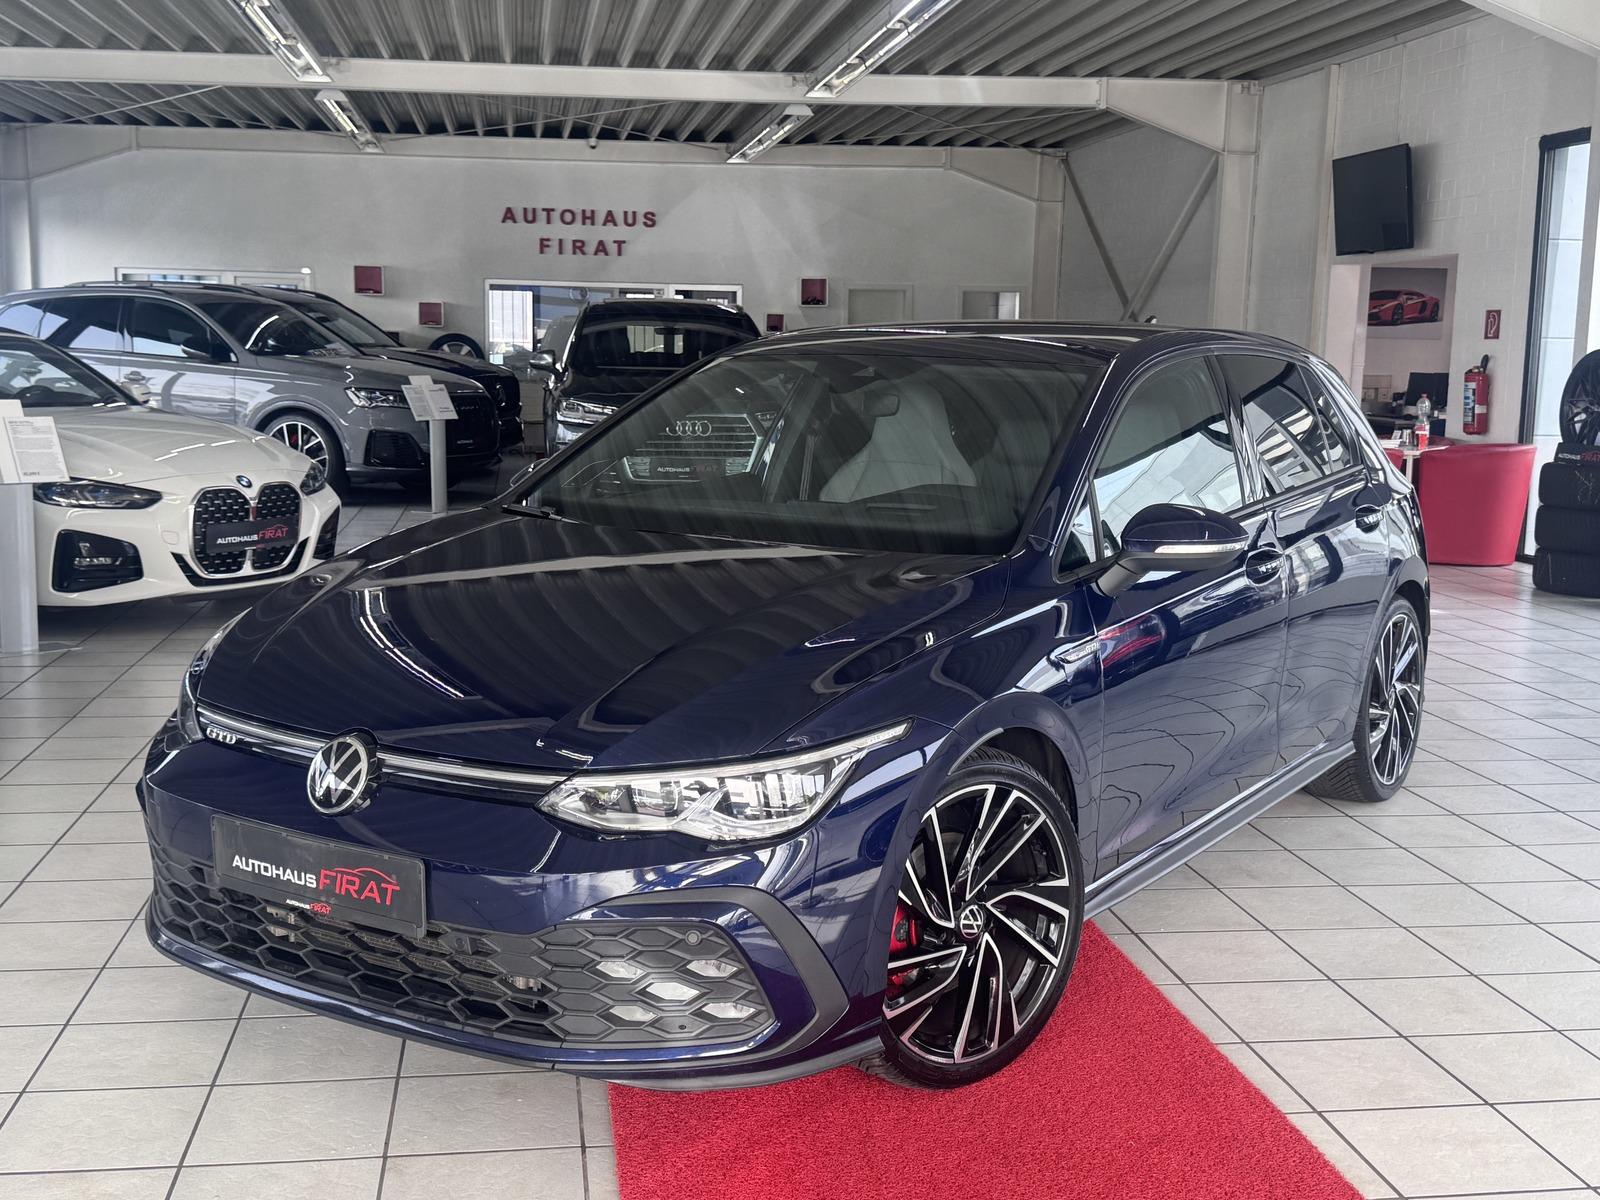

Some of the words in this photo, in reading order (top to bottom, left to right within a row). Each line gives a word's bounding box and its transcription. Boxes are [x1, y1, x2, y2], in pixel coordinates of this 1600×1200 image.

[501, 207, 657, 228] AUTOHAUS
[538, 238, 627, 257] FIRAT
[216, 535, 258, 544] AUTOHAUS
[258, 527, 288, 539] FIRAT
[206, 727, 237, 744] GTD
[232, 855, 316, 888] AUTOHAUS
[319, 869, 401, 906] FIRAT
[286, 899, 310, 909] AUTOHAUS
[310, 903, 331, 914] FIRAT
